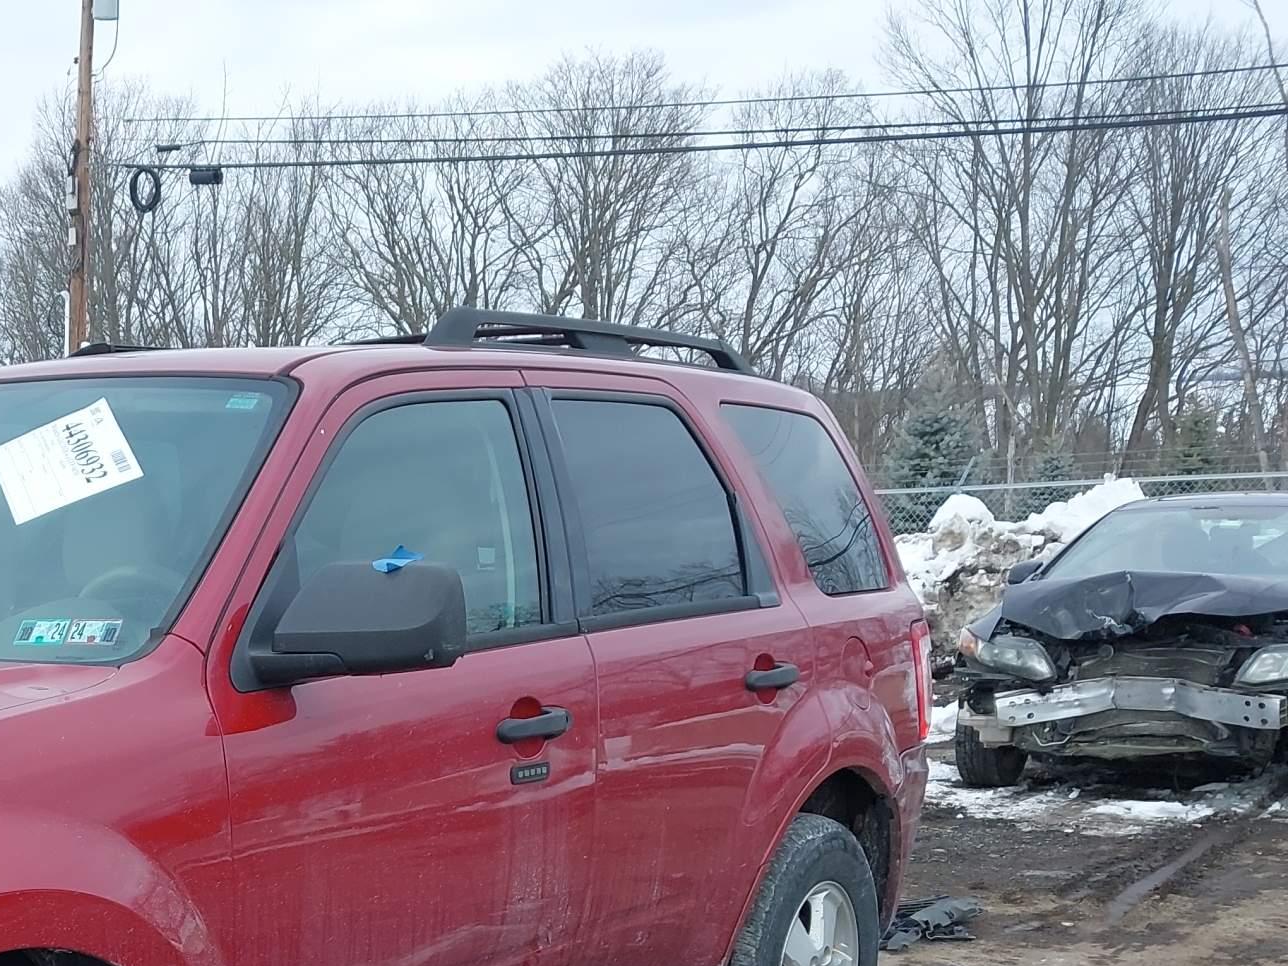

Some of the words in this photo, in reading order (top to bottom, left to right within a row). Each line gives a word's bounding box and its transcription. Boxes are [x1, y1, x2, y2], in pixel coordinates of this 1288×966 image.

[62, 421, 108, 484] 44306932
[51, 622, 67, 640] 24
[71, 622, 87, 640] 24
